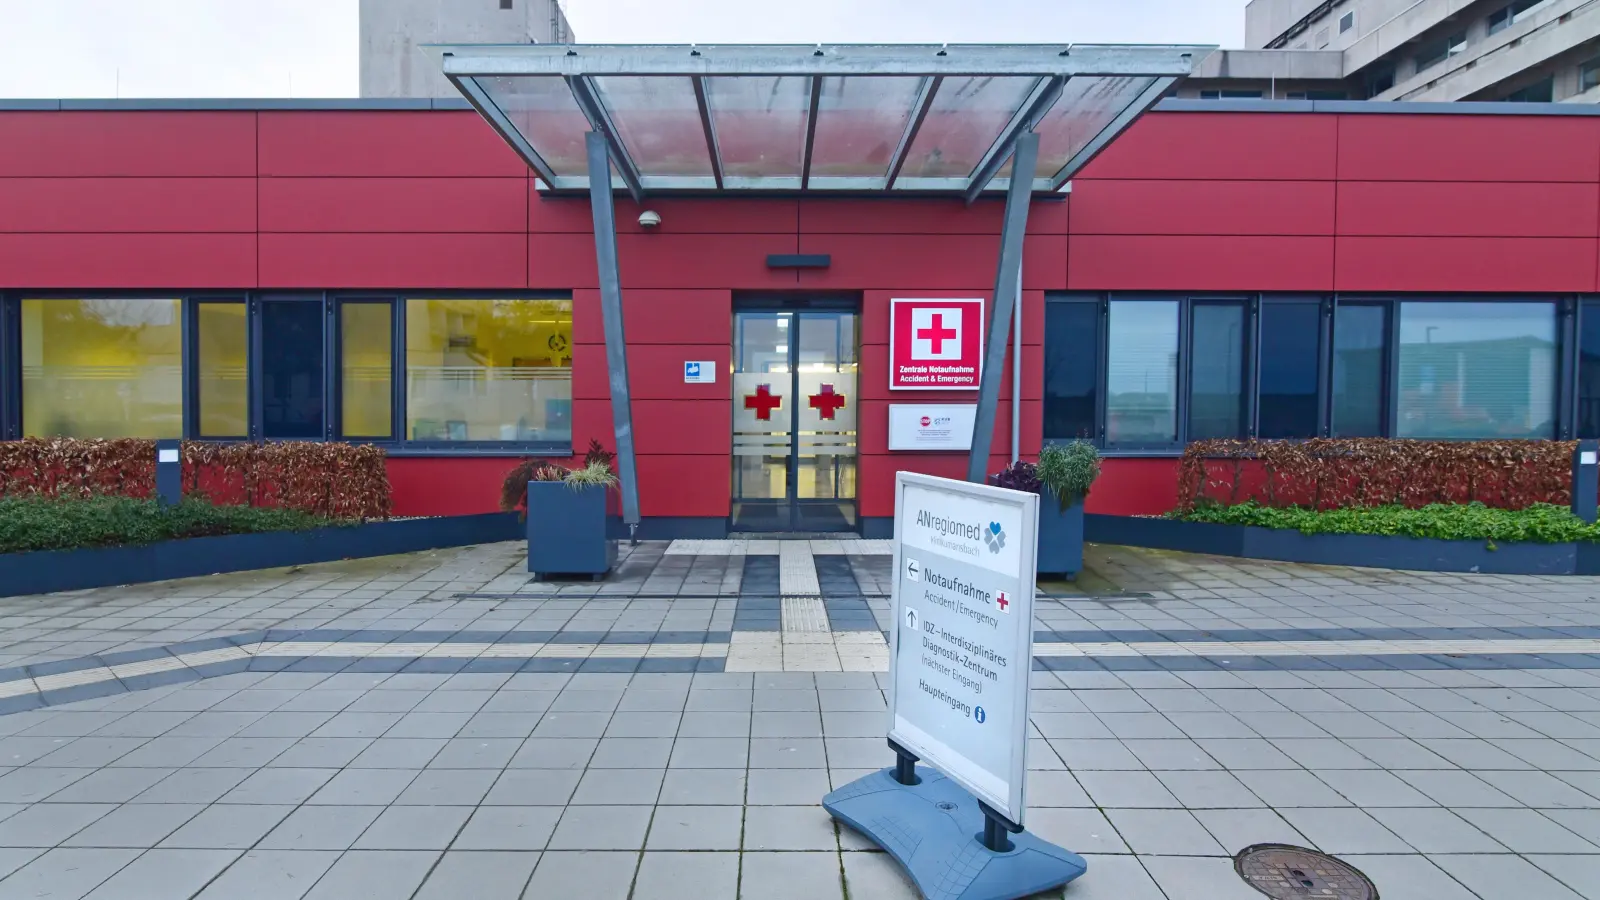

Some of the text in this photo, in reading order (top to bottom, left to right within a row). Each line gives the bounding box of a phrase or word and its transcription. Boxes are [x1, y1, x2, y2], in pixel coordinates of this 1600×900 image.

[900, 365, 975, 373] Zentrale Notaufnahme
[900, 375, 974, 384] Accident & Emergency
[916, 509, 980, 541] ANregiomed
[924, 567, 991, 605] Notaufnahme
[921, 652, 982, 694] (nächster Eingang)
[922, 636, 998, 681] Diagnostik-Zentrum
[918, 678, 971, 718] Haupteingang
